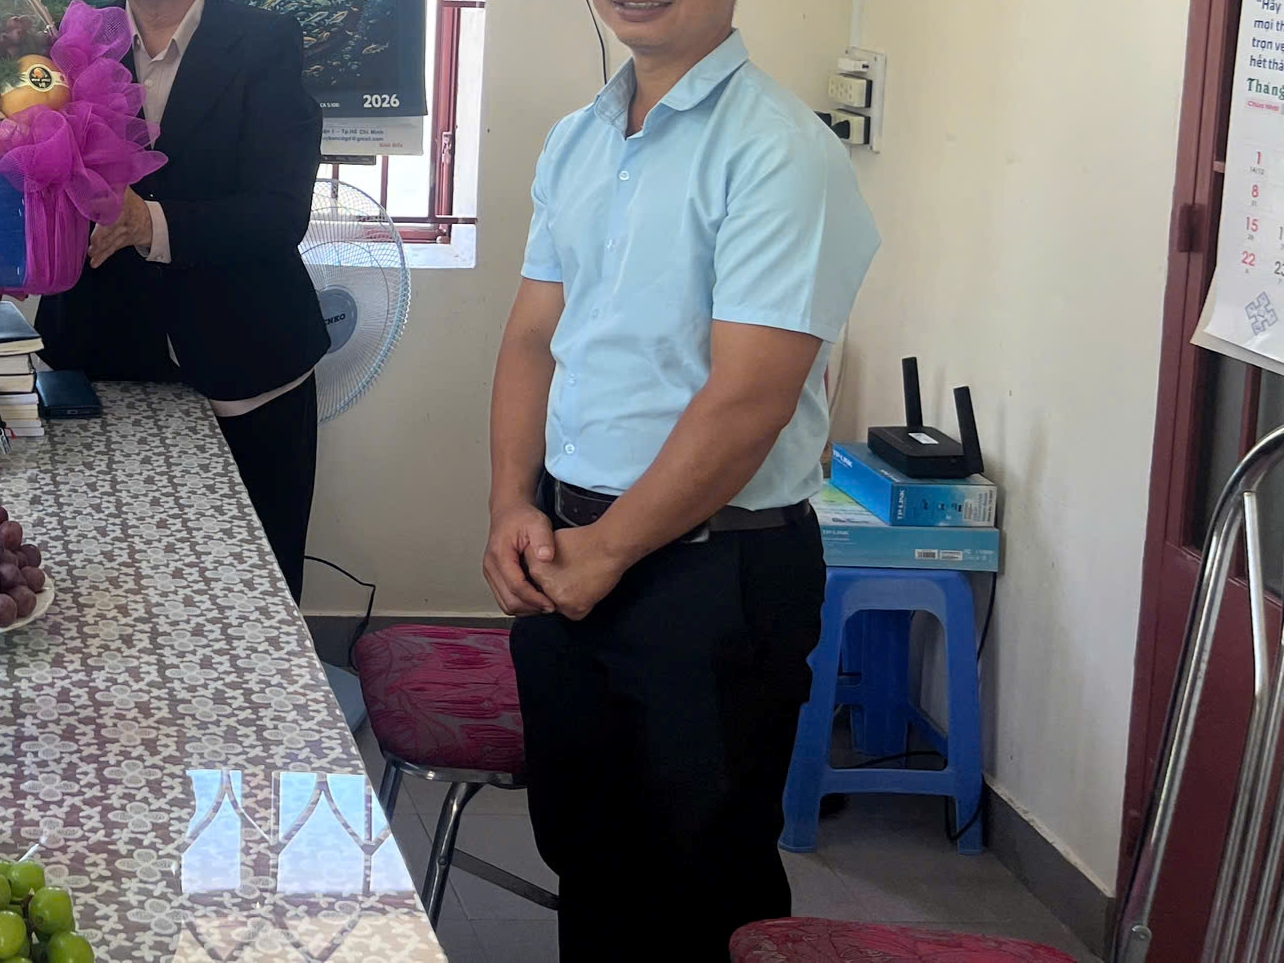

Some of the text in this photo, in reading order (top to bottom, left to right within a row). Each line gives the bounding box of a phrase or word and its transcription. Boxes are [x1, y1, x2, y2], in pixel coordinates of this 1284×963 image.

[1253, 18, 1274, 32] mọi
[1252, 37, 1273, 52] trọn
[1249, 54, 1267, 69] hết
[1246, 77, 1284, 101] Tháng
[362, 93, 400, 108] 2026
[1257, 151, 1262, 165] 1
[1251, 184, 1259, 198] 8
[1246, 216, 1259, 232] 15
[1241, 250, 1256, 267] 22
